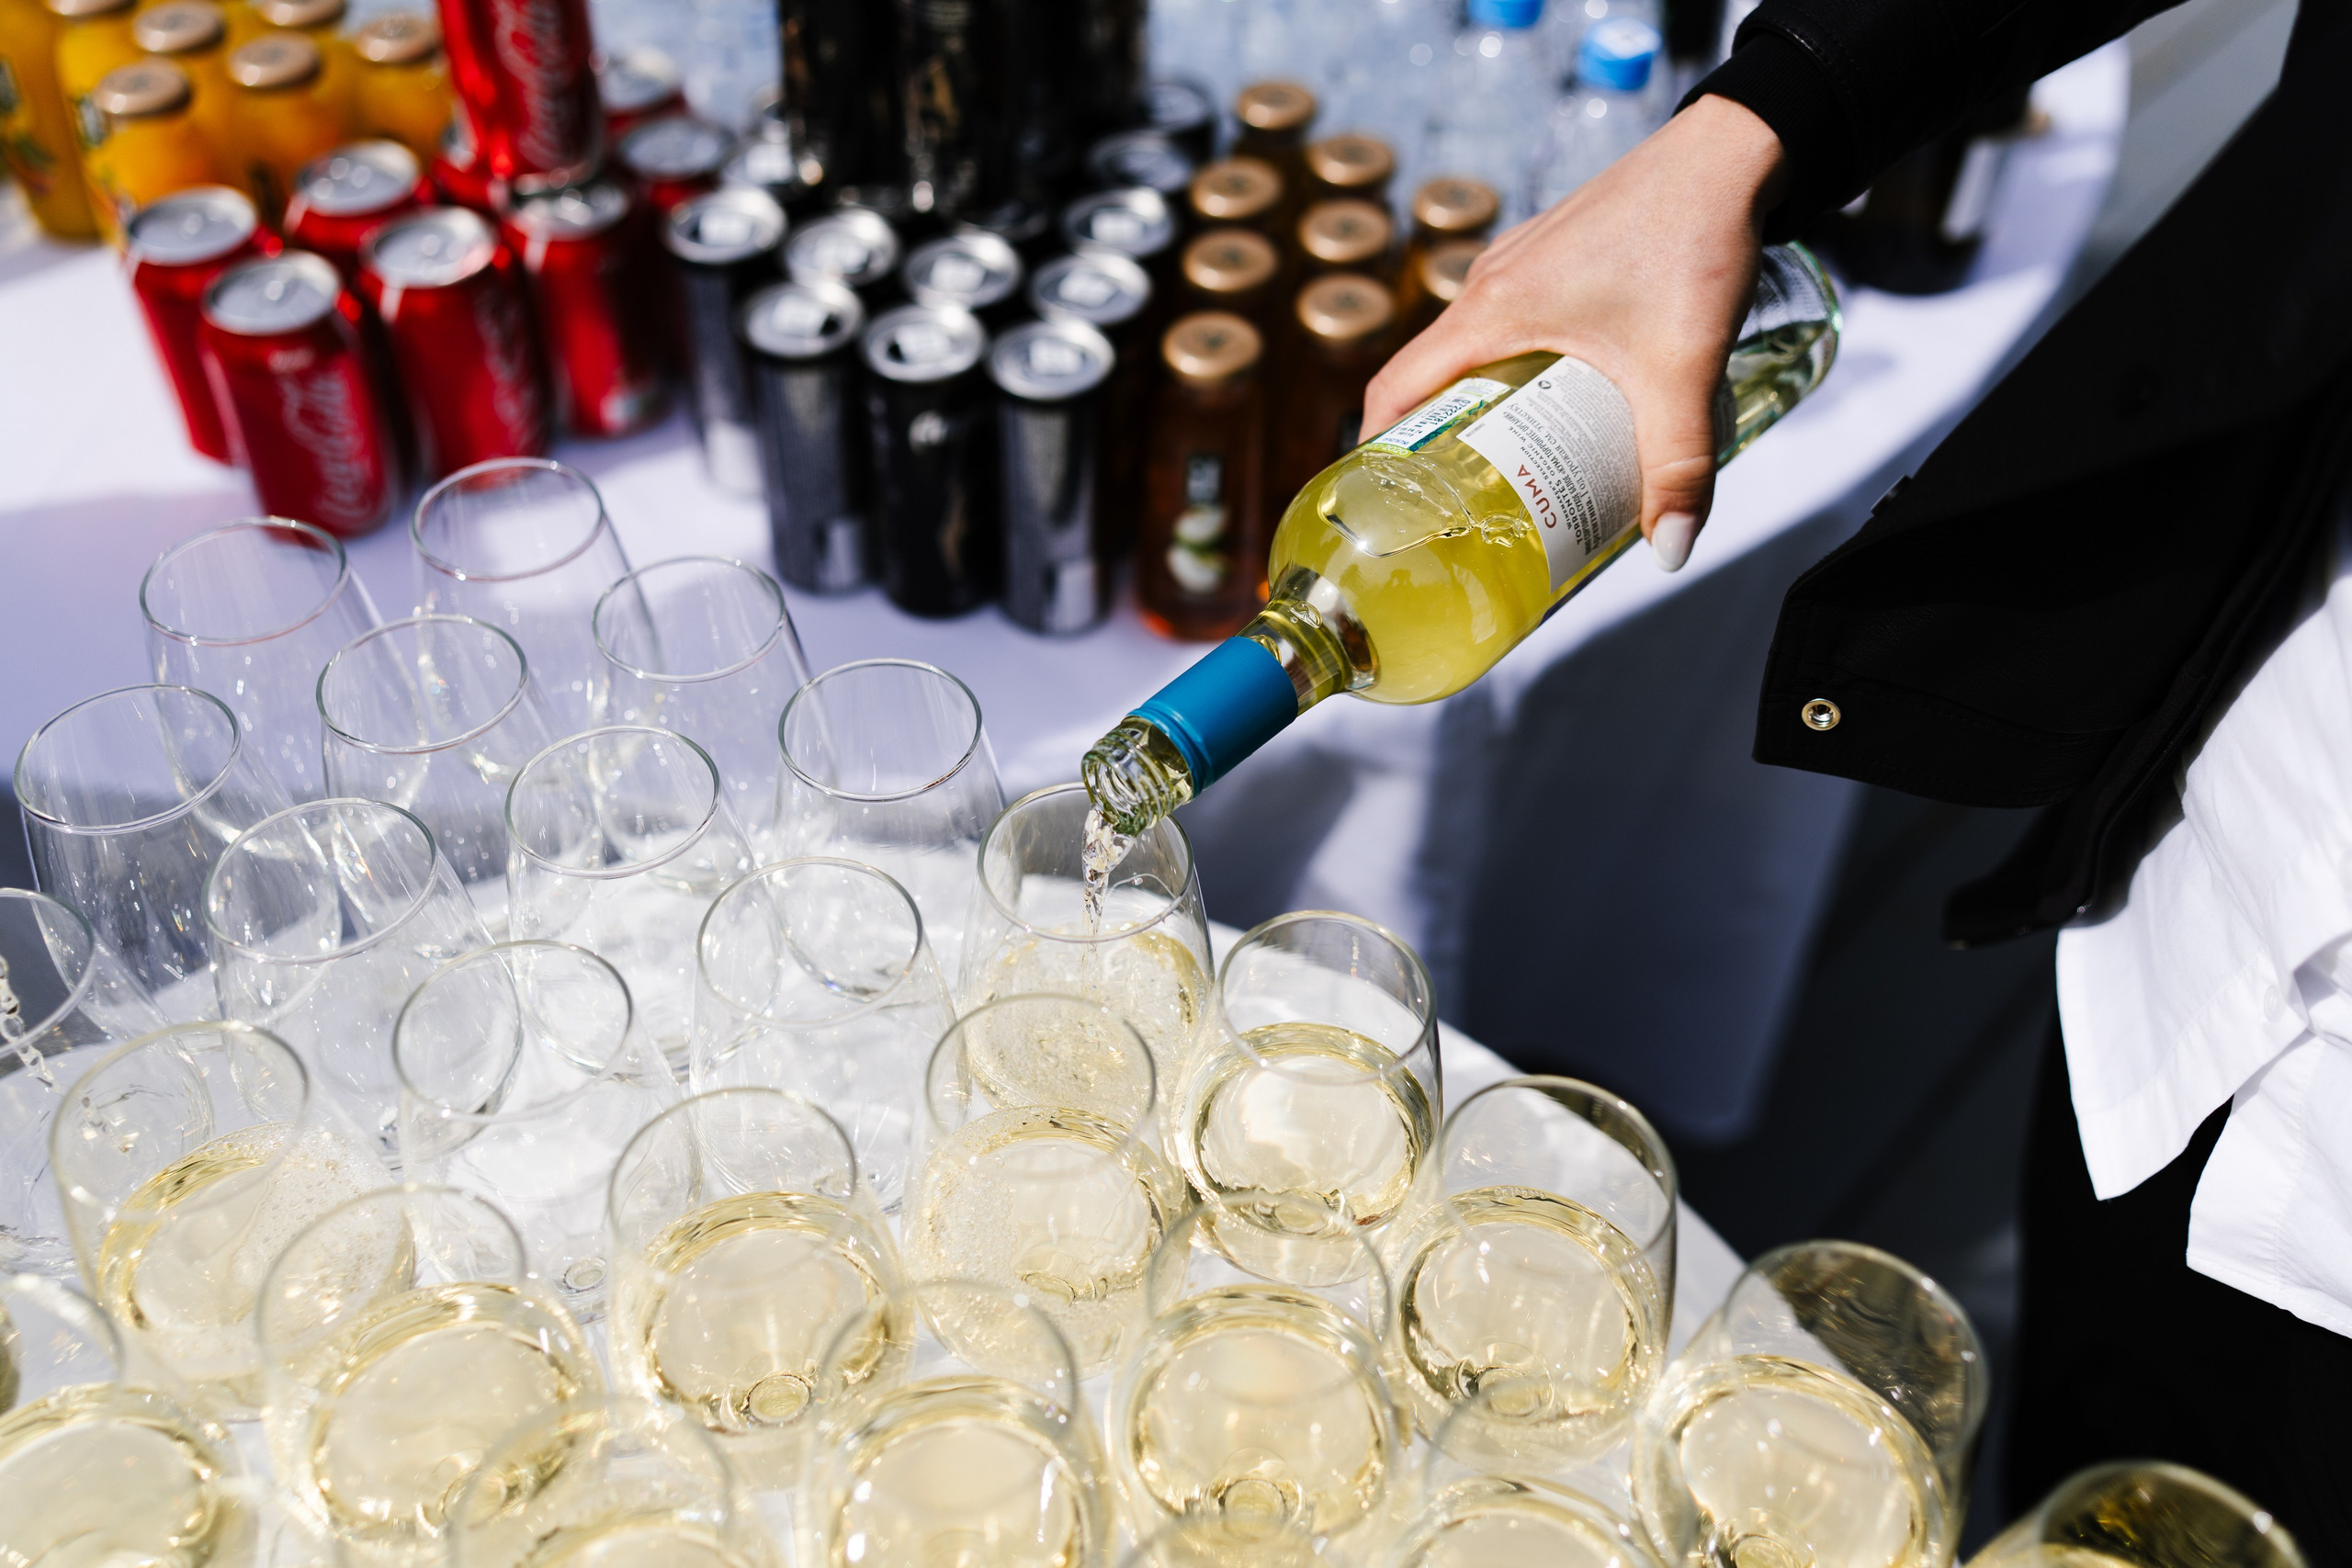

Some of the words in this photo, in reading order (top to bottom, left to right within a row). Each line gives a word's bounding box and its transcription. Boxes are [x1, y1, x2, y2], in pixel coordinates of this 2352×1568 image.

[1507, 403, 1544, 431] этикетку
[1508, 425, 1525, 442] WINE
[1526, 429, 1553, 457] ТОРРОНТЕС
[1544, 431, 1556, 444] см.
[1526, 443, 1554, 476] ORGANIC
[1555, 445, 1581, 477] урожая
[1517, 463, 1557, 529] CUMA
[1562, 474, 1576, 493] БЕЛОЕ
[1576, 477, 1588, 497] Год
[1555, 479, 1581, 545] TORRONTÉS
[1572, 492, 1583, 512] СУХОЕ
[1586, 496, 1600, 549] Аргентина.
